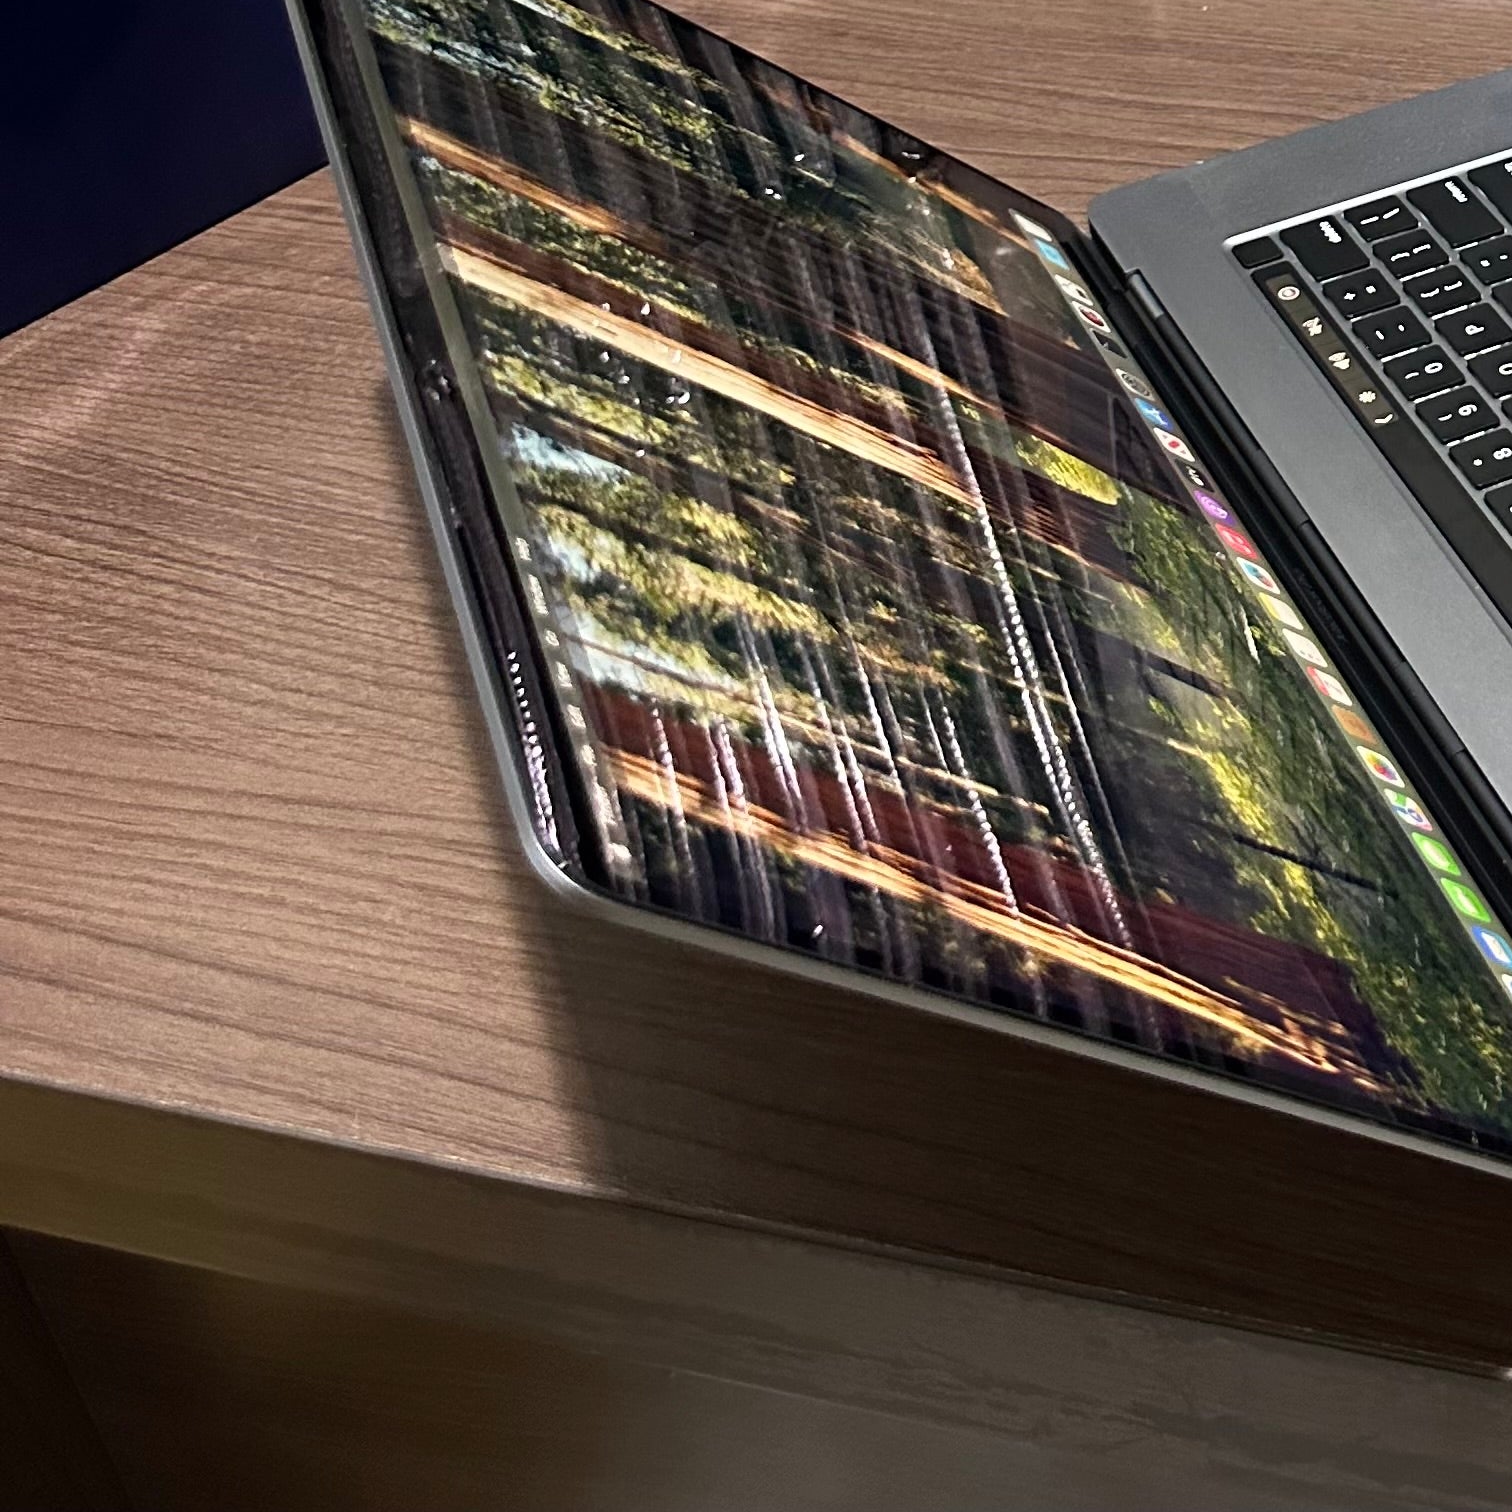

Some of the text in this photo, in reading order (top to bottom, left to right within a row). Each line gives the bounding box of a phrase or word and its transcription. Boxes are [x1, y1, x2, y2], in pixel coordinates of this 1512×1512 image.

[1464, 324, 1485, 336] P
[1457, 403, 1478, 417] 9
[1492, 447, 1512, 461] 8
